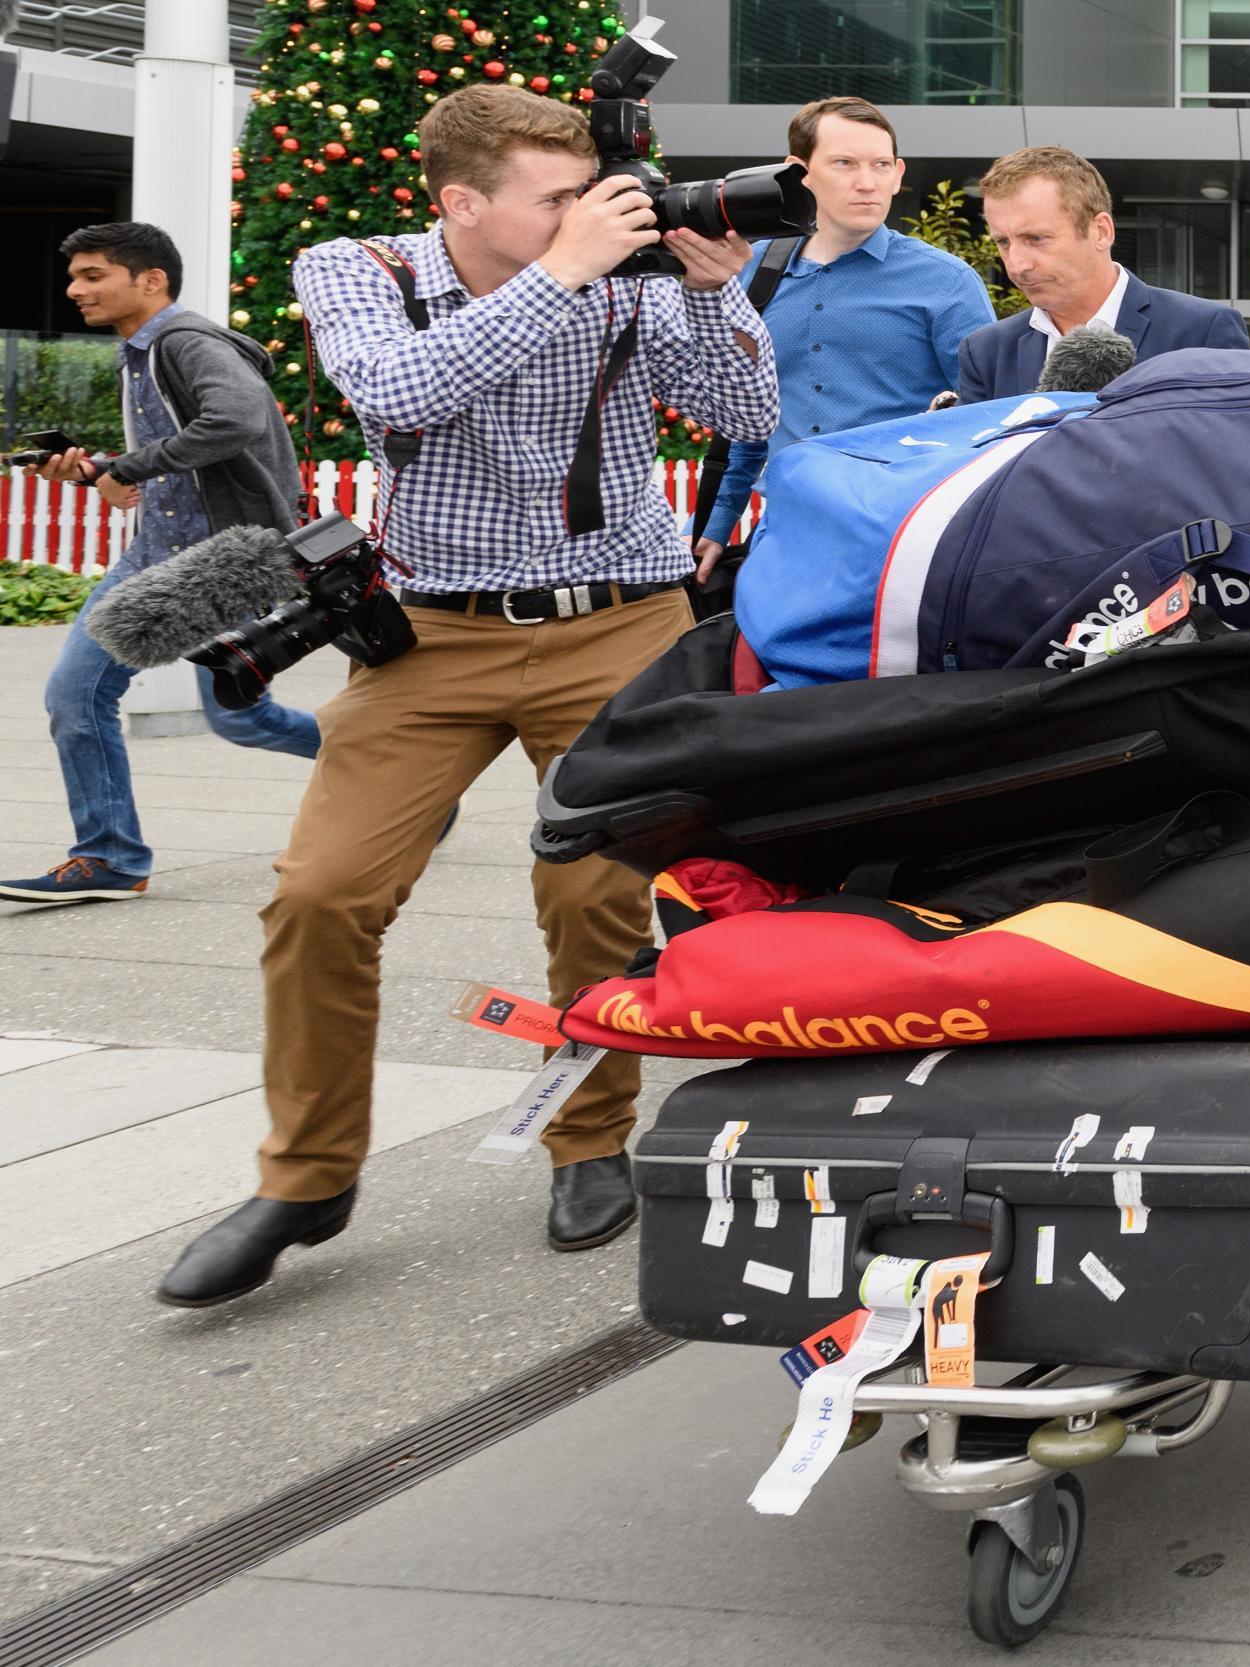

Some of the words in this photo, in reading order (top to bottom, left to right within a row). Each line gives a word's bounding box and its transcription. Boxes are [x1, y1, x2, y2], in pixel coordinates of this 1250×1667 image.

[690, 1006, 990, 1049] balance
[510, 1103, 544, 1136] Stick
[930, 1360, 970, 1373] HEAVY
[792, 1428, 829, 1474] Stick
[818, 1397, 834, 1421] He
